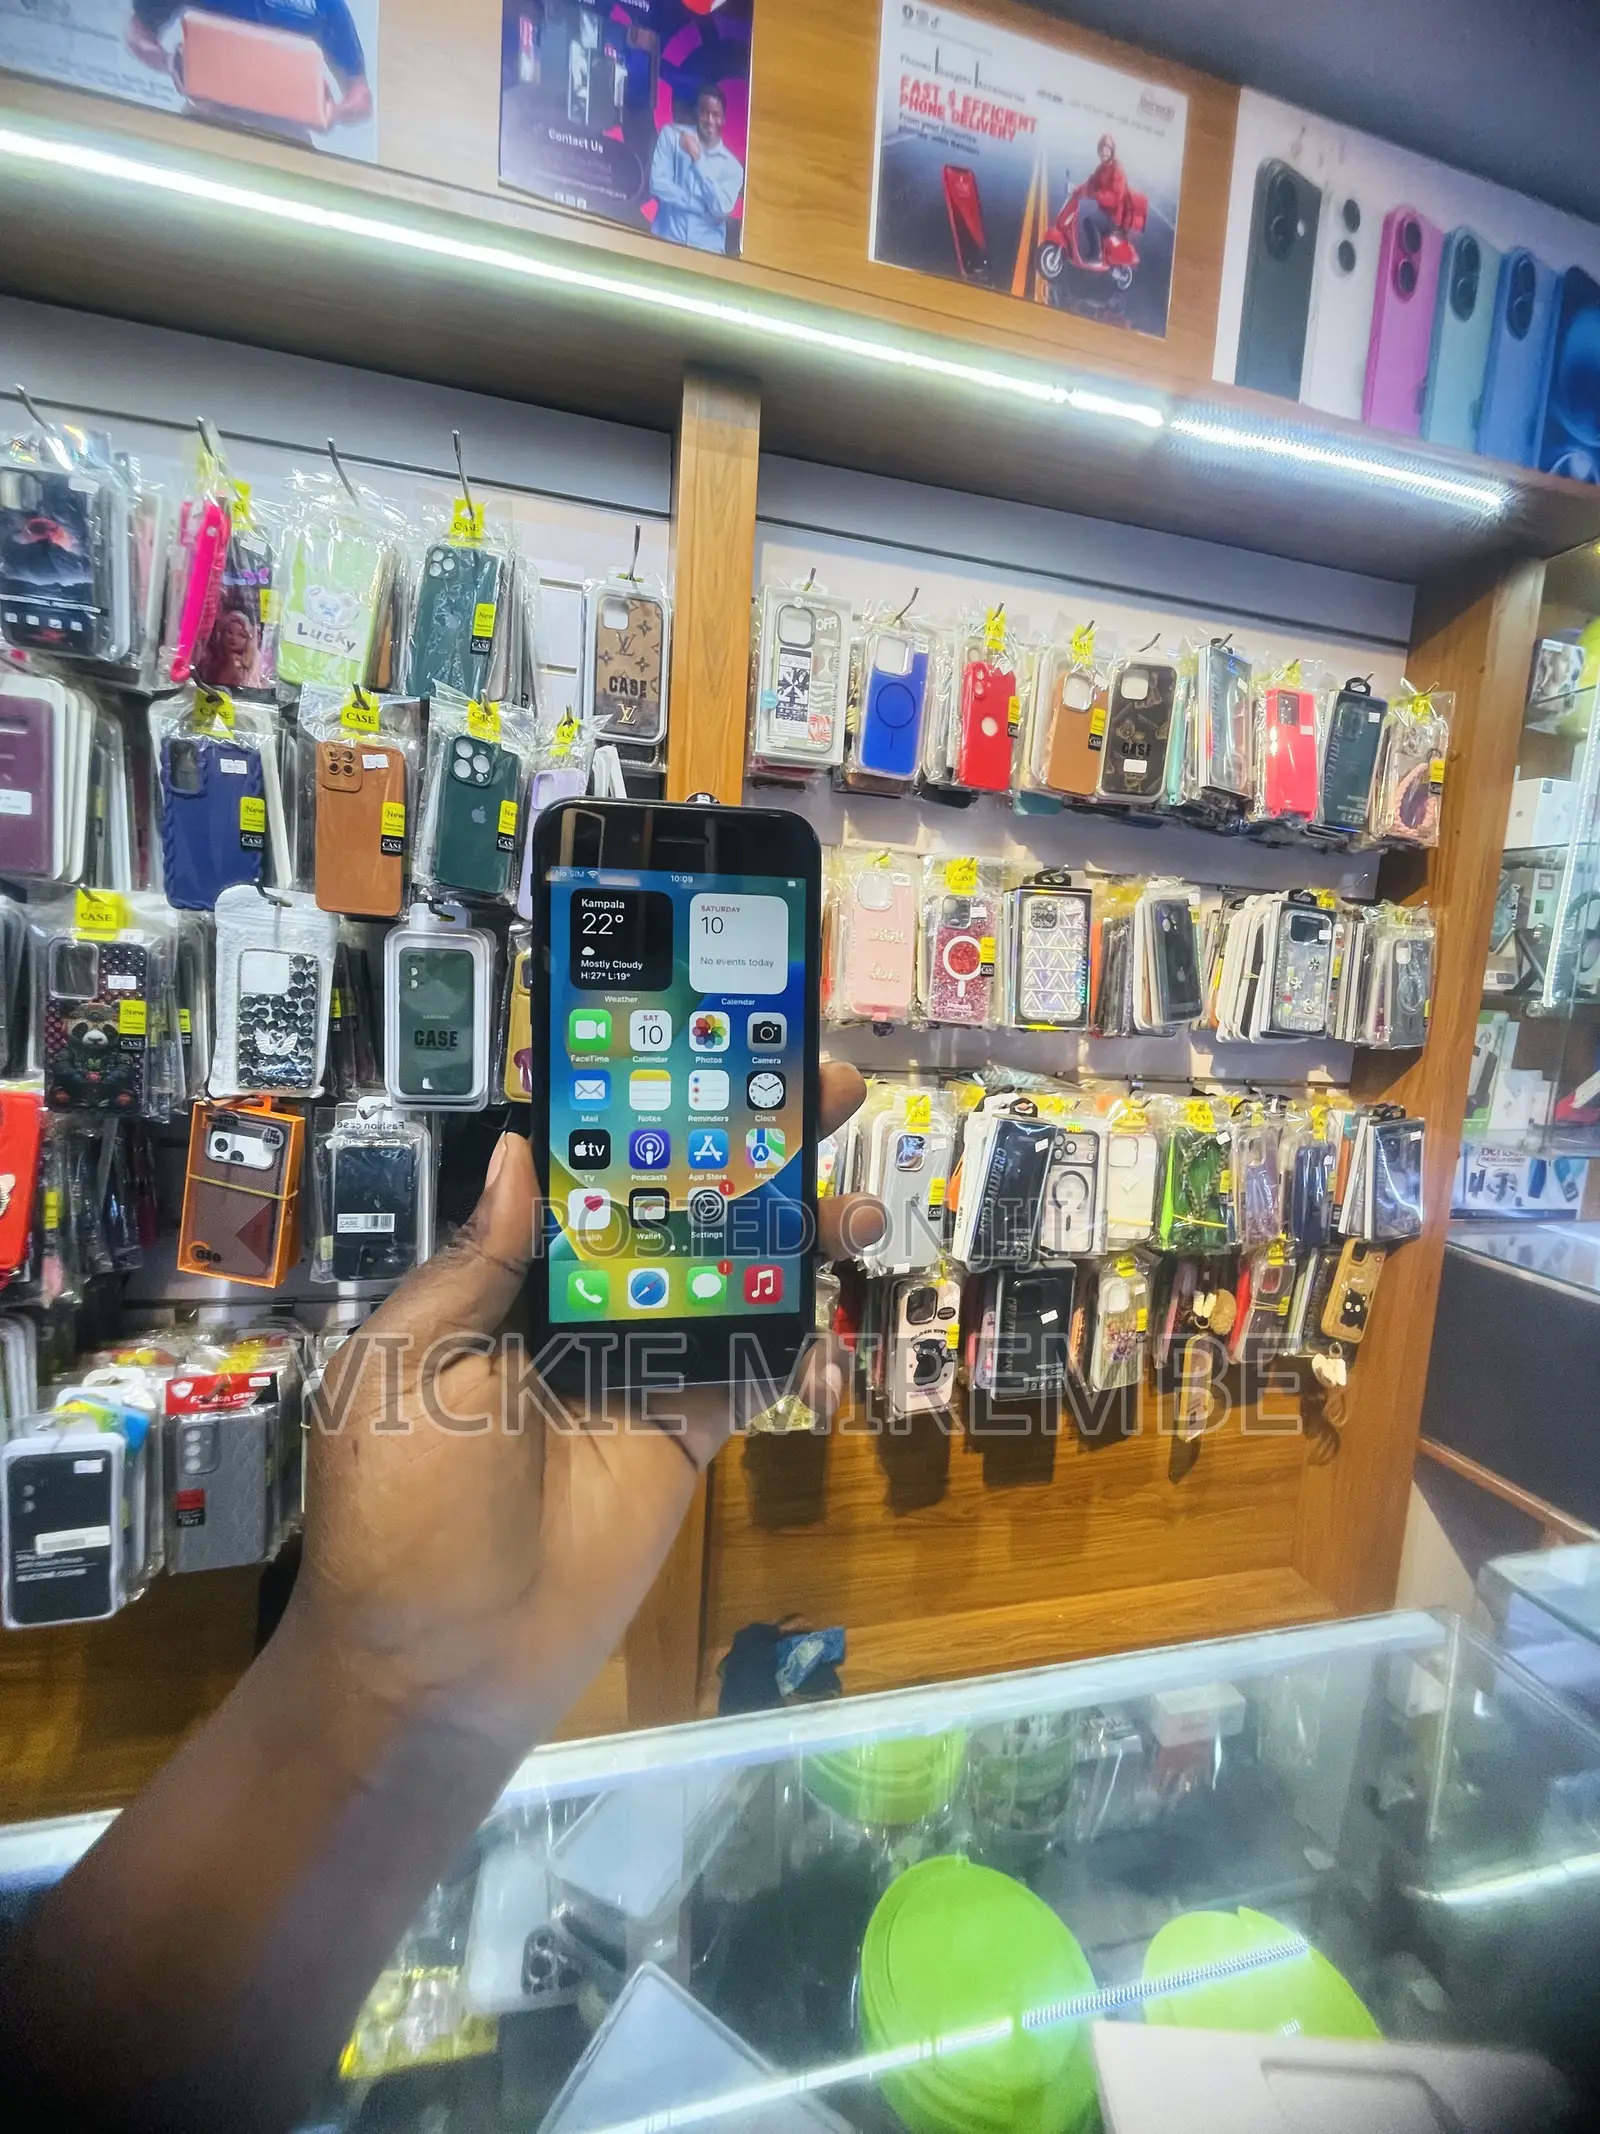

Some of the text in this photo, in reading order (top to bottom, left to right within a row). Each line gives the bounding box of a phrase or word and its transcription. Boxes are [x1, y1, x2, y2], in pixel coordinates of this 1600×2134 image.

[900, 74, 941, 104] FAST
[962, 94, 1037, 134] EFFICIENT
[899, 92, 1016, 142] PHONE DELIVERY
[549, 129, 604, 154] Contact Us
[297, 622, 357, 662] Lucky
[608, 675, 648, 698] CASE
[346, 712, 376, 725] CASE
[246, 805, 265, 815] New
[386, 809, 404, 820] New
[670, 874, 694, 884] 10:09
[581, 898, 625, 910] Kampala
[701, 905, 741, 913] SATURDAY
[81, 913, 112, 922] CASE
[582, 912, 624, 935] 22°
[701, 916, 724, 935] 10
[580, 959, 643, 971] Mostly Cloudy
[700, 956, 775, 968] No events today
[580, 971, 631, 981] H:27° L:19°
[604, 995, 638, 1004] Weather
[721, 997, 756, 1006] Calendar
[126, 1008, 144, 1017] New
[643, 1014, 658, 1022] SAT
[414, 1030, 458, 1047] CASE
[637, 1025, 663, 1045] 10
[120, 1038, 144, 1048] CASE
[571, 1055, 610, 1063] FaceTime
[632, 1055, 669, 1064] Calendar
[695, 1056, 723, 1064] Photos
[752, 1057, 782, 1065] Camera
[581, 1115, 599, 1123] Mail
[638, 1114, 662, 1123] Notes
[688, 1114, 729, 1123] Reminders
[755, 1114, 777, 1123] Clock
[584, 1174, 595, 1183] TV
[631, 1173, 668, 1182] Podcasts
[688, 1172, 728, 1183] App Store
[636, 1232, 662, 1241] Wallet
[690, 1229, 724, 1239] Settings
[910, 1328, 933, 1342] BLACK
[190, 1391, 257, 1404] Faion case
